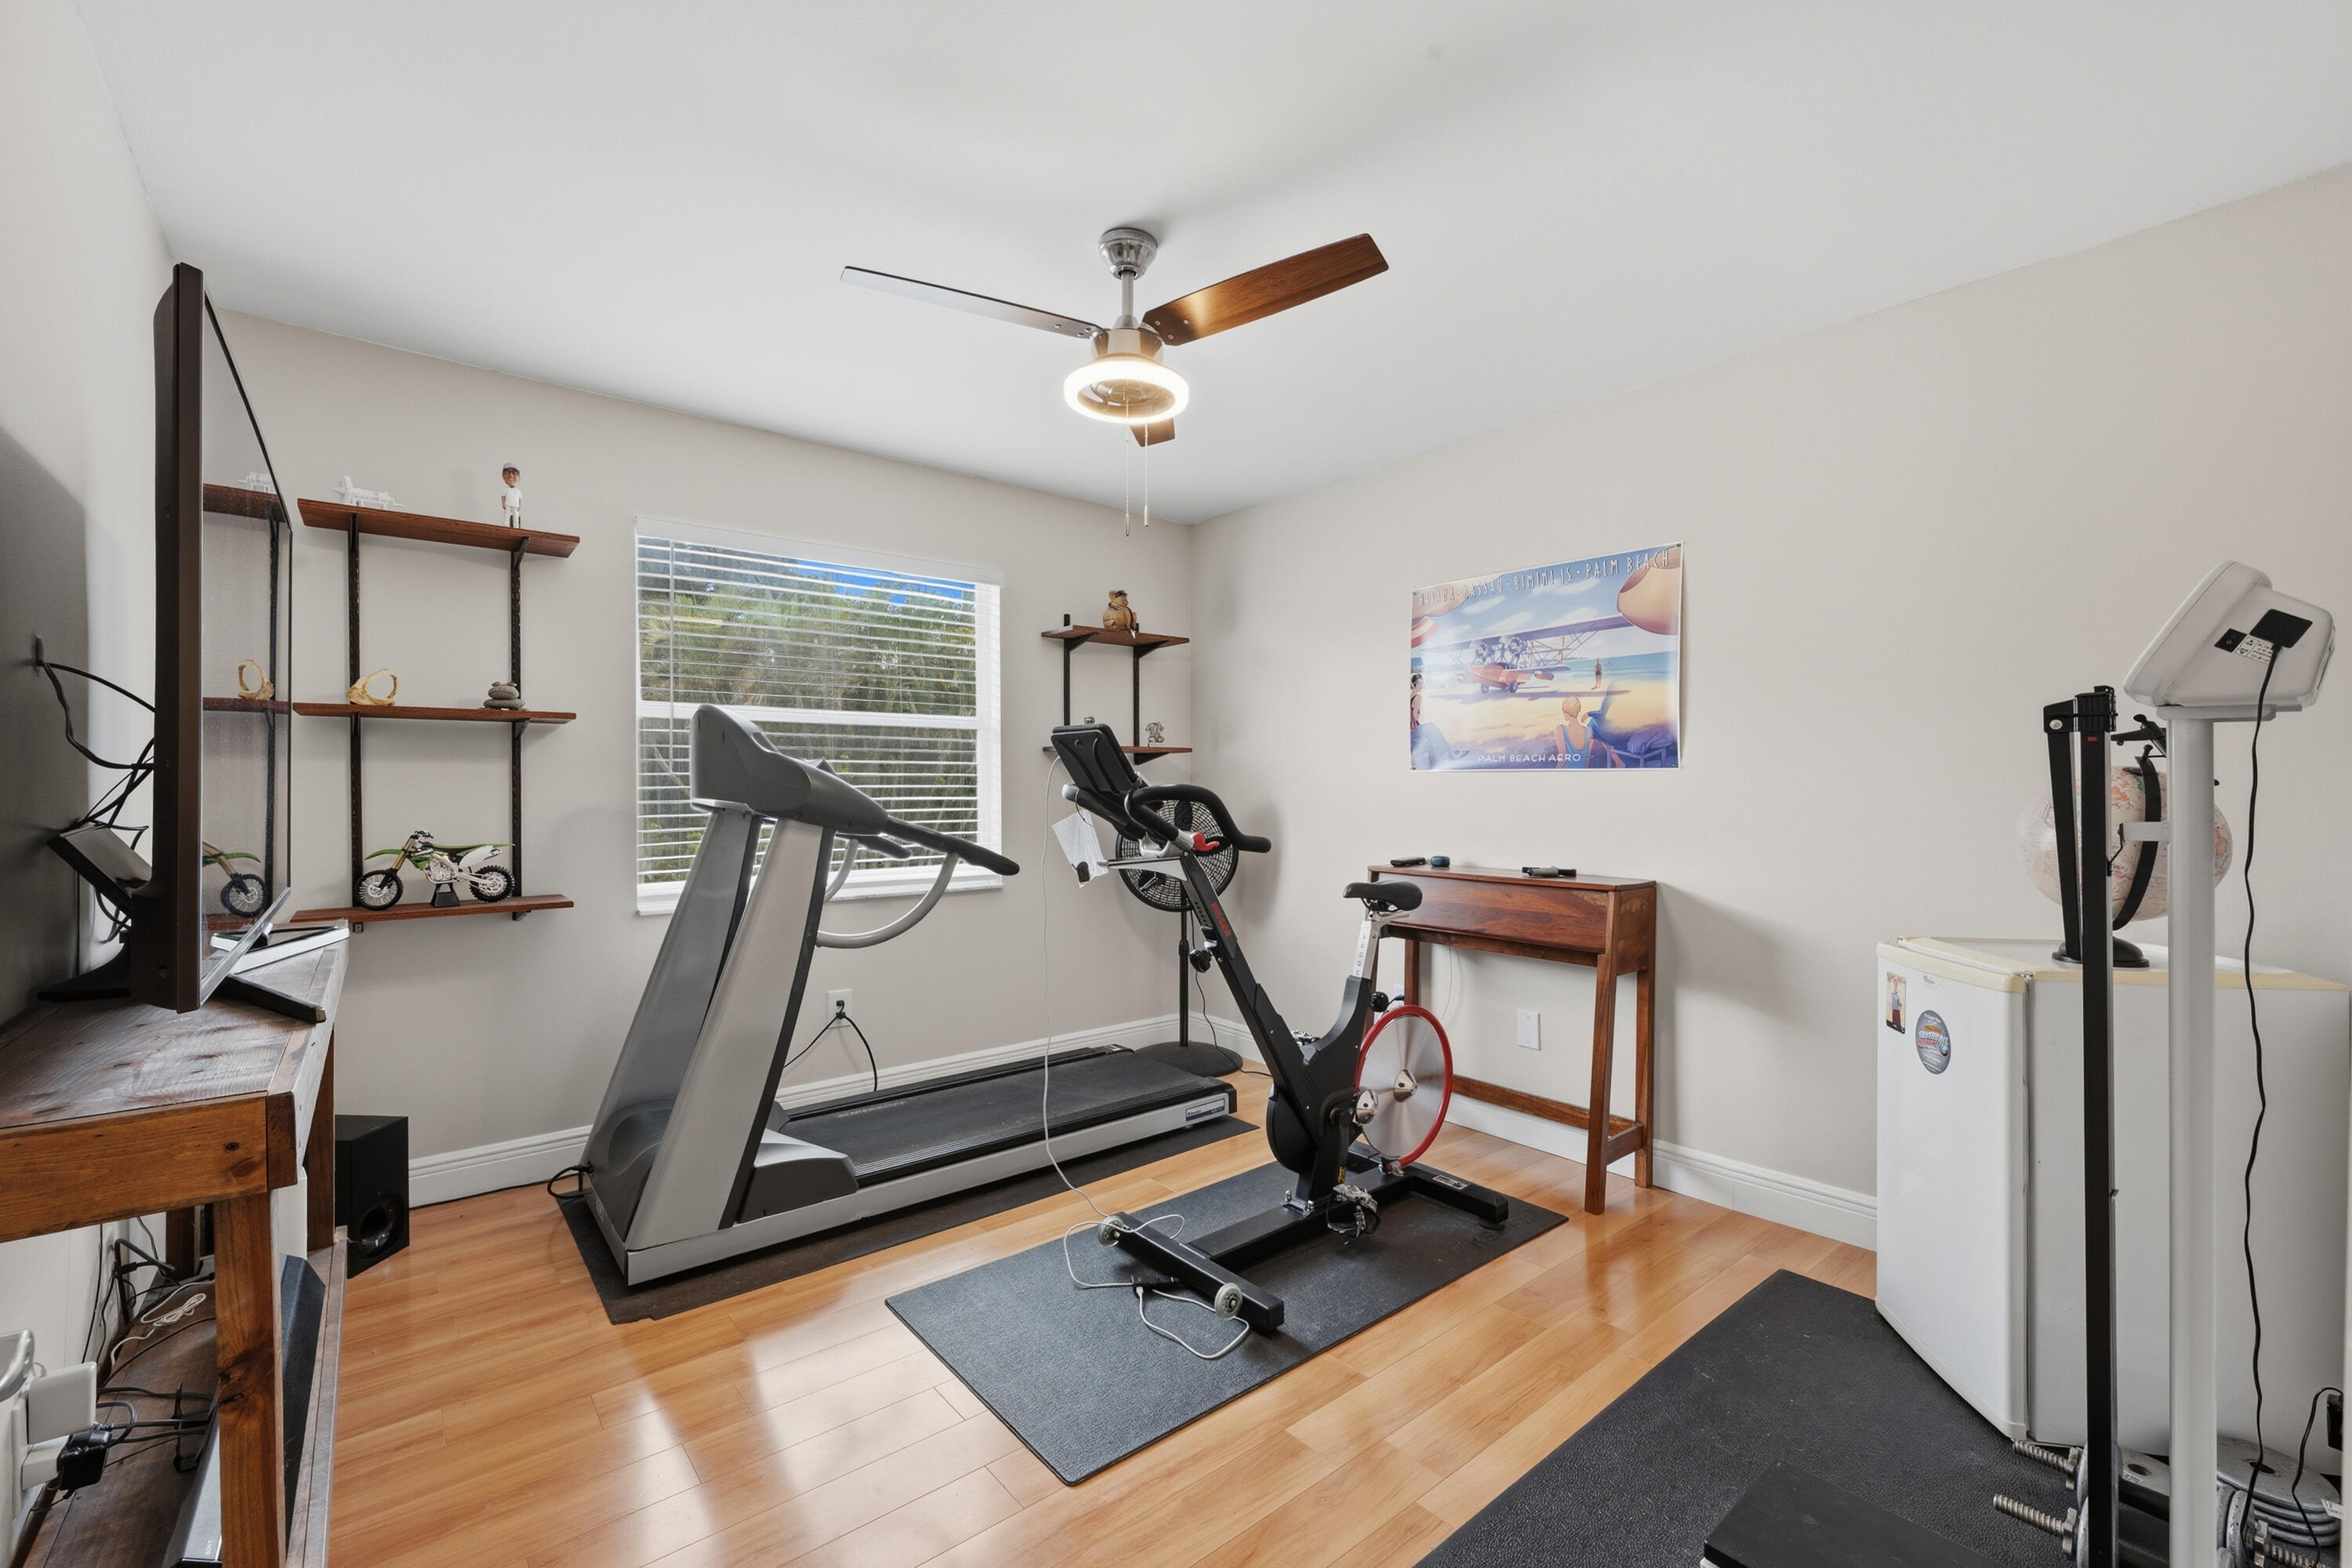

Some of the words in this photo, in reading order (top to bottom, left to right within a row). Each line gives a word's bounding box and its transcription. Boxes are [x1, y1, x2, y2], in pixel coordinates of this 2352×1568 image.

[1462, 576, 1504, 597] NASSAU
[1514, 569, 1555, 591] BIMINI
[1586, 559, 1619, 579] PALM
[1627, 550, 1670, 574] BEACH
[1478, 753, 1506, 763] PALM
[1509, 753, 1546, 763] BEACH
[1548, 753, 1582, 763] AERO
